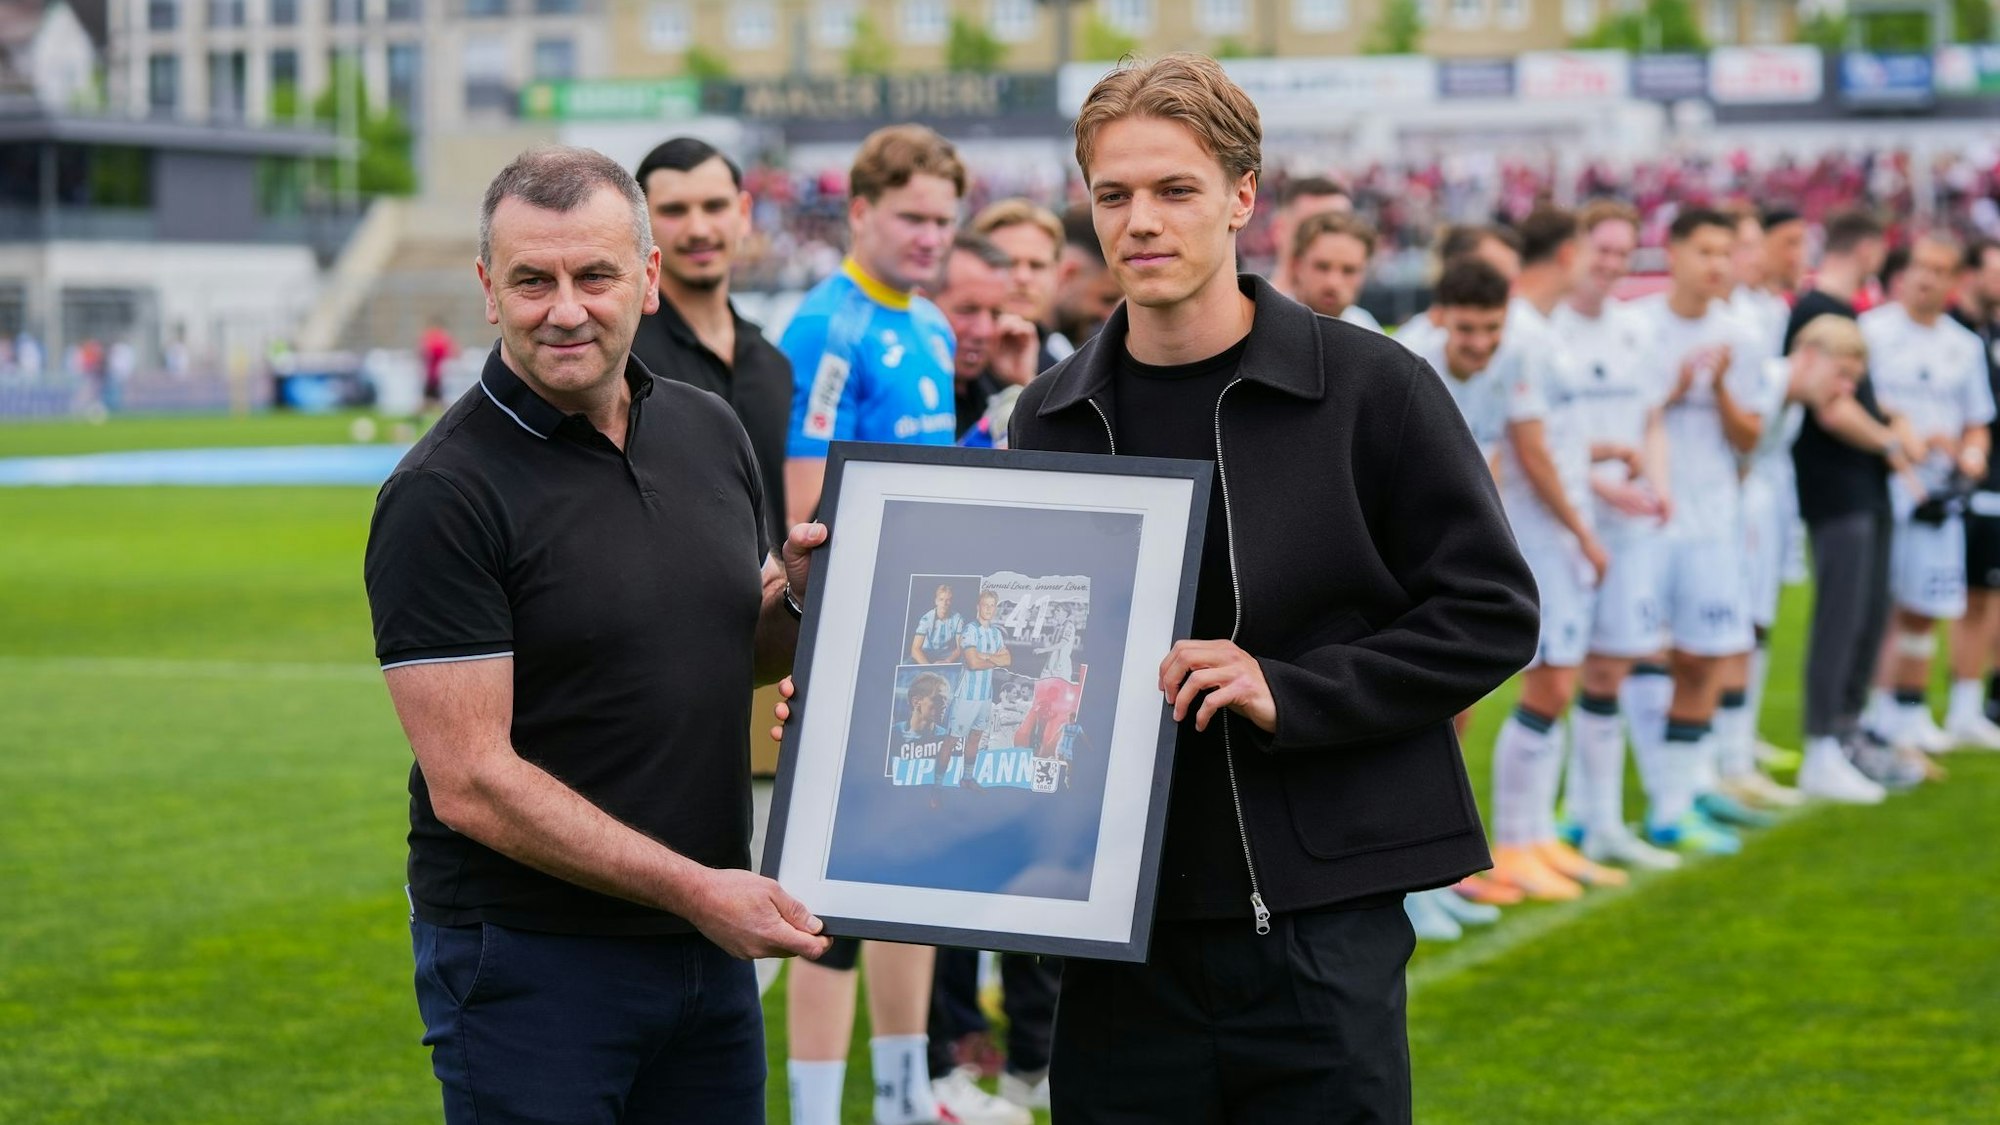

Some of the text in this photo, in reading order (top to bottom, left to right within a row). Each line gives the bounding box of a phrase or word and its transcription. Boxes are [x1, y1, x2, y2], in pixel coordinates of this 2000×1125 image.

[1004, 593, 1051, 639] 41
[900, 736, 963, 760] Clems
[892, 752, 1034, 786] LIPANN
